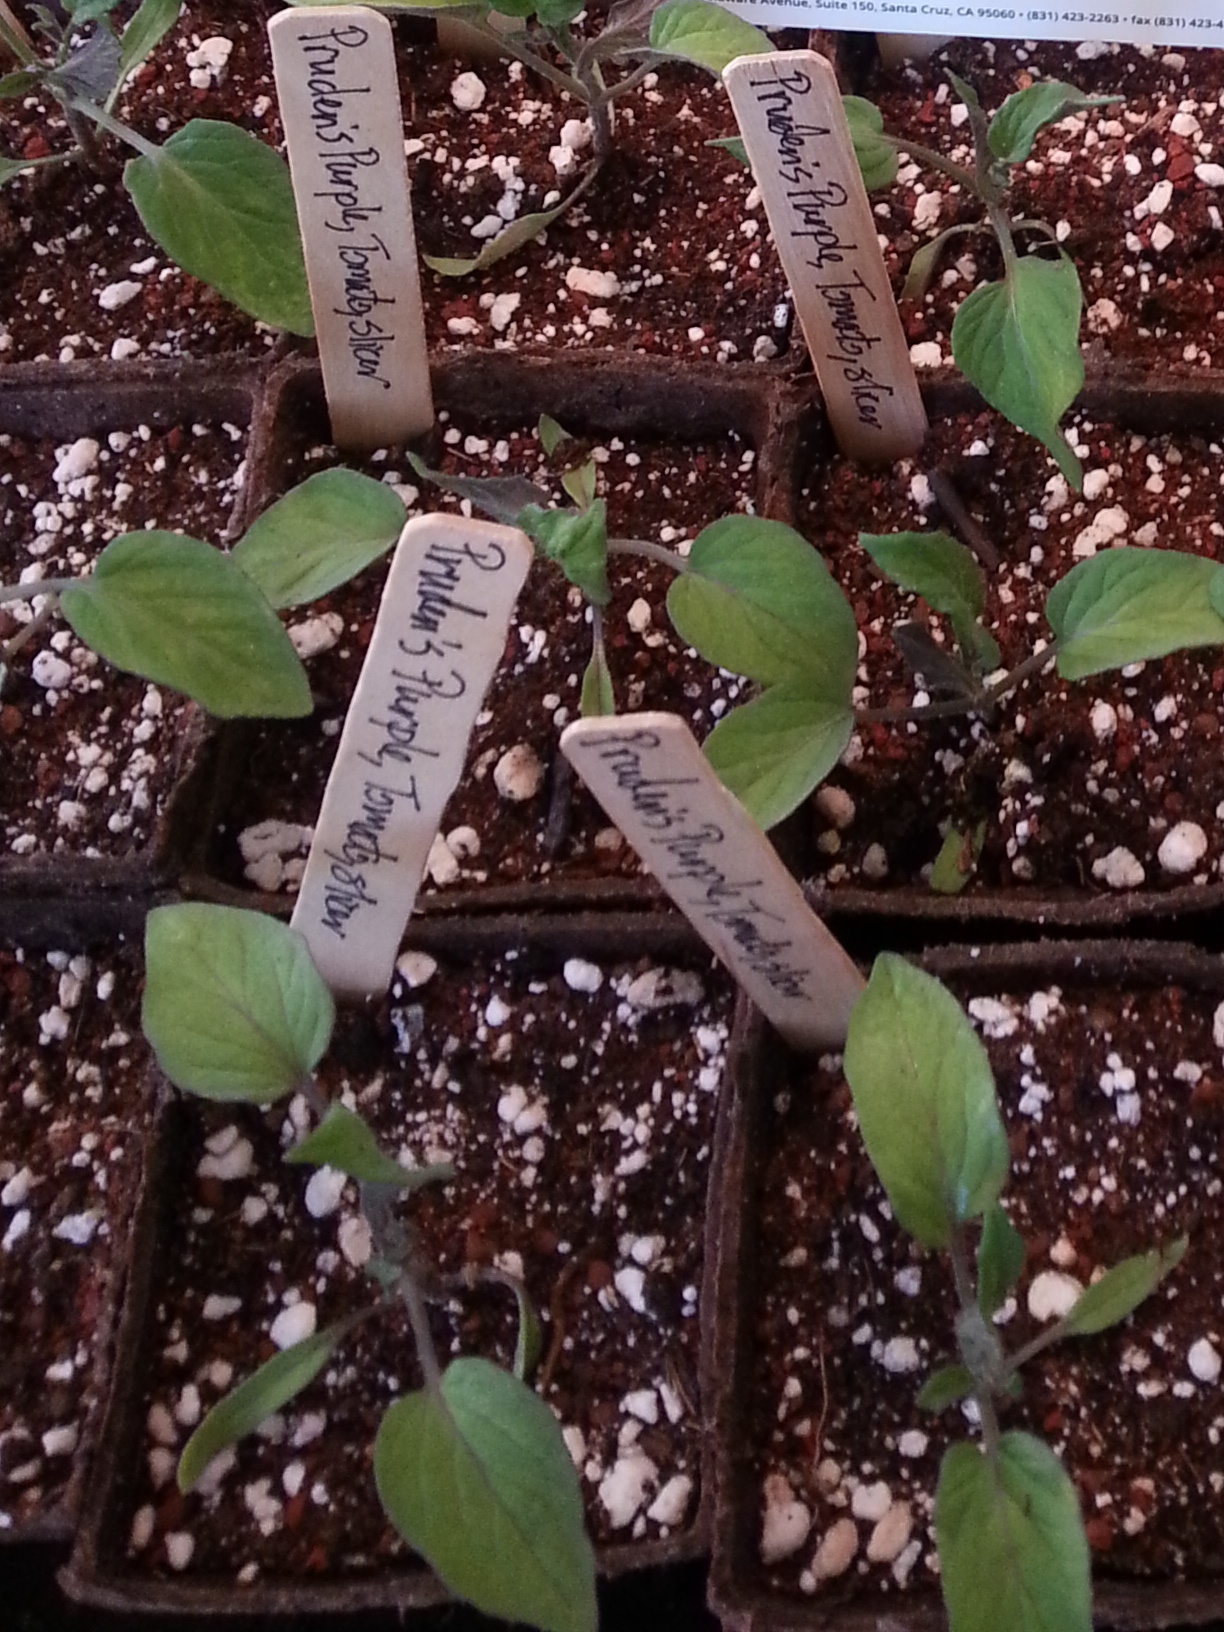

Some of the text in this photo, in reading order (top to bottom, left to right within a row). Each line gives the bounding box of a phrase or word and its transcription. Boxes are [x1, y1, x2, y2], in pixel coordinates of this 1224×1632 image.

[816, 0, 848, 10] Suite
[852, 1, 877, 12] 150,
[881, 2, 917, 14] Santa
[921, 5, 952, 16] Cruz,
[957, 7, 974, 17] CA
[977, 8, 1015, 19] 95060
[1027, 11, 1059, 22] (831)
[1062, 11, 1119, 23] 423-2263
[1131, 15, 1150, 24] fax
[1154, 17, 1186, 27] (831)
